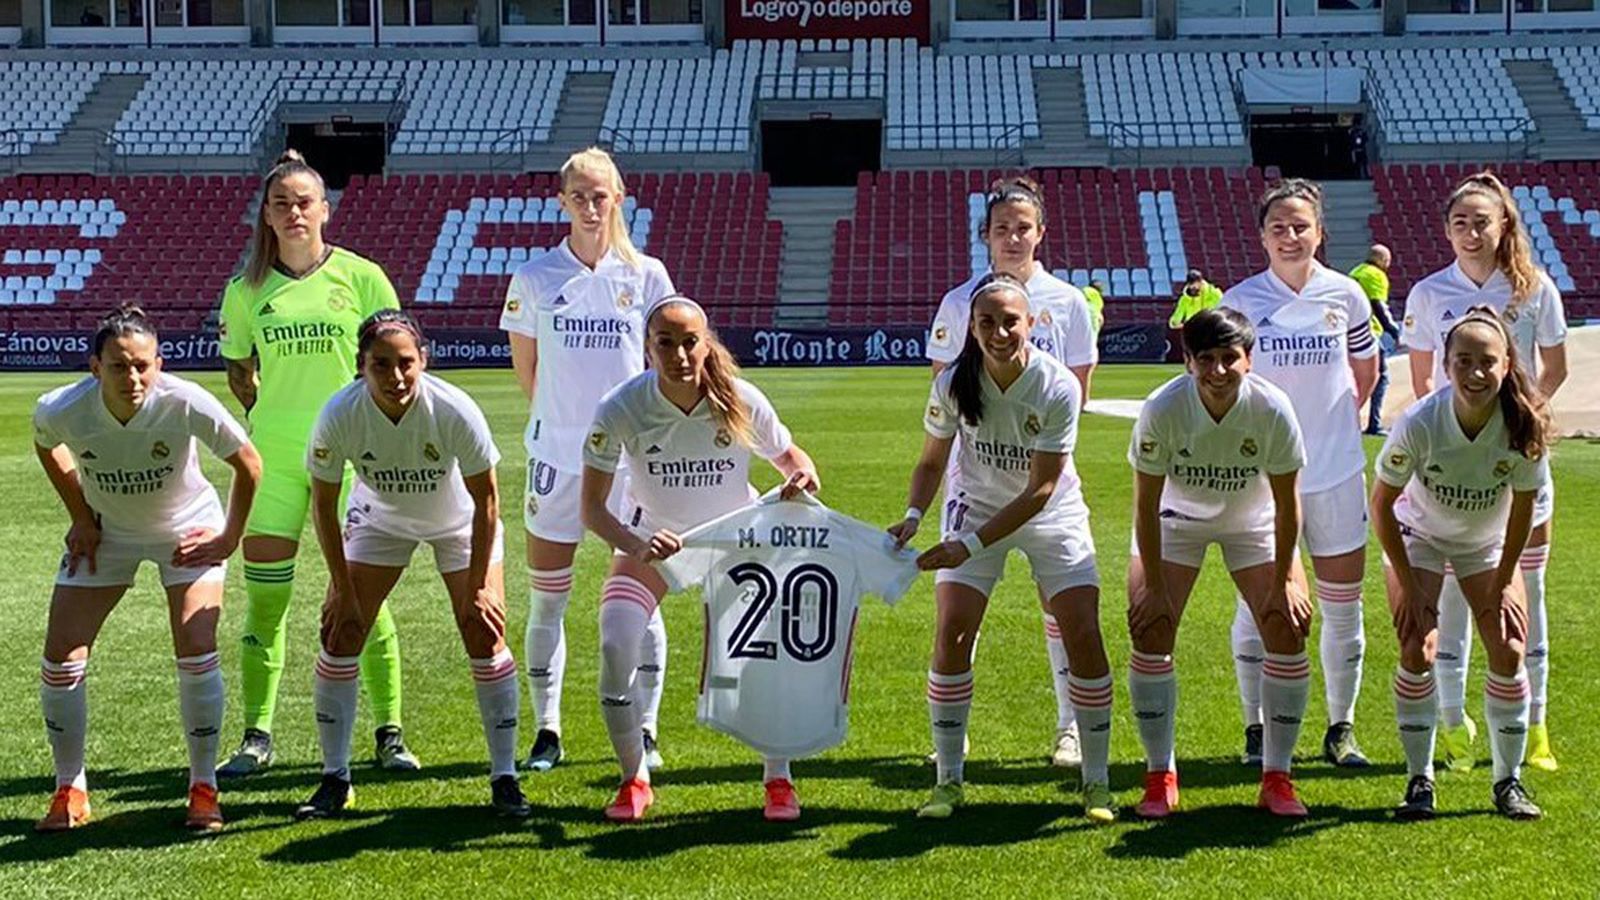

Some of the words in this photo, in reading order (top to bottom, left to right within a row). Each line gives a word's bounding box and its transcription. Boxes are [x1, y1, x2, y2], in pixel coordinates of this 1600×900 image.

[263, 322, 345, 344] Emirates
[553, 314, 632, 333] Emirates
[277, 340, 294, 357] FLY
[297, 339, 334, 354] BETTER
[564, 334, 581, 349] FLY
[584, 335, 622, 349] BETTER
[754, 331, 851, 363] Monte
[1260, 332, 1340, 352] Emirates
[1272, 353, 1290, 366] FLY
[1293, 351, 1331, 366] BETTER
[648, 457, 736, 476] Emirates
[1174, 464, 1260, 480] Emirates
[398, 482, 438, 493] BETTER
[662, 476, 680, 487] FLY
[684, 474, 723, 487] BETTER
[738, 528, 761, 548] M.
[770, 526, 829, 548] ORTIZ
[727, 562, 838, 662] 20
